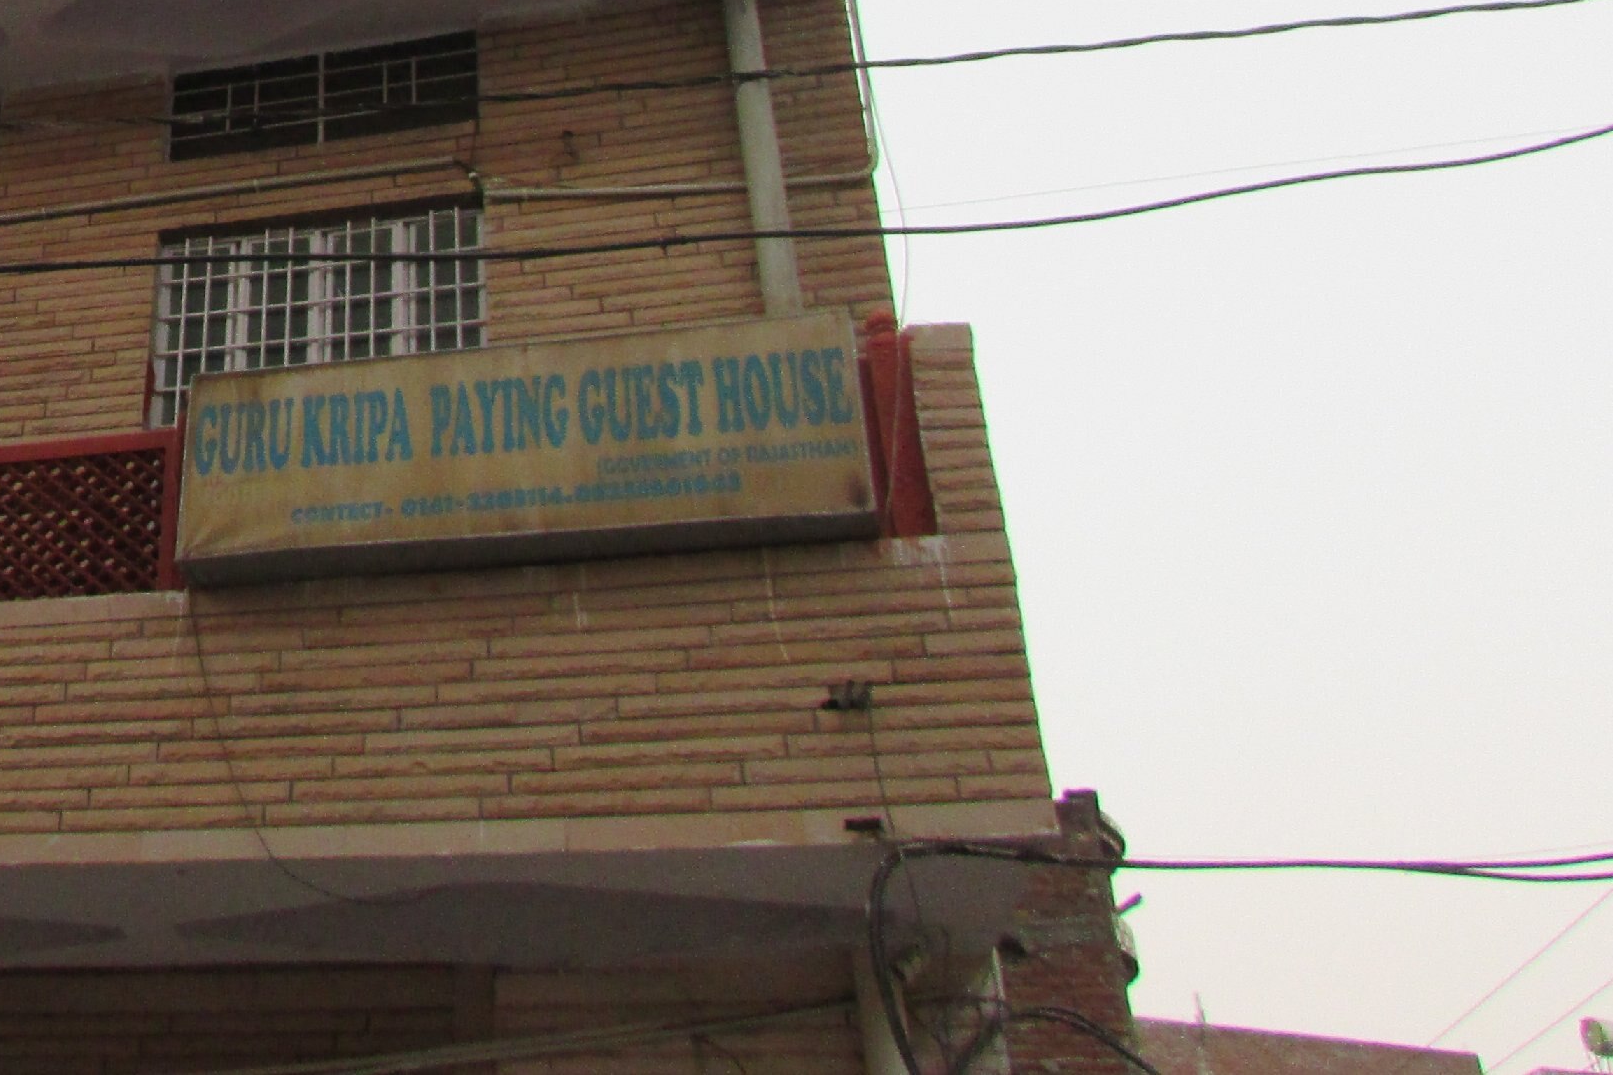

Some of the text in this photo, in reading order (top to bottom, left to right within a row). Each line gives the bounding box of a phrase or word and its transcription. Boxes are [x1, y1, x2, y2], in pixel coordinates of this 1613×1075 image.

[194, 346, 854, 476] GURU KRIPA PAYING GUEST HOUSE
